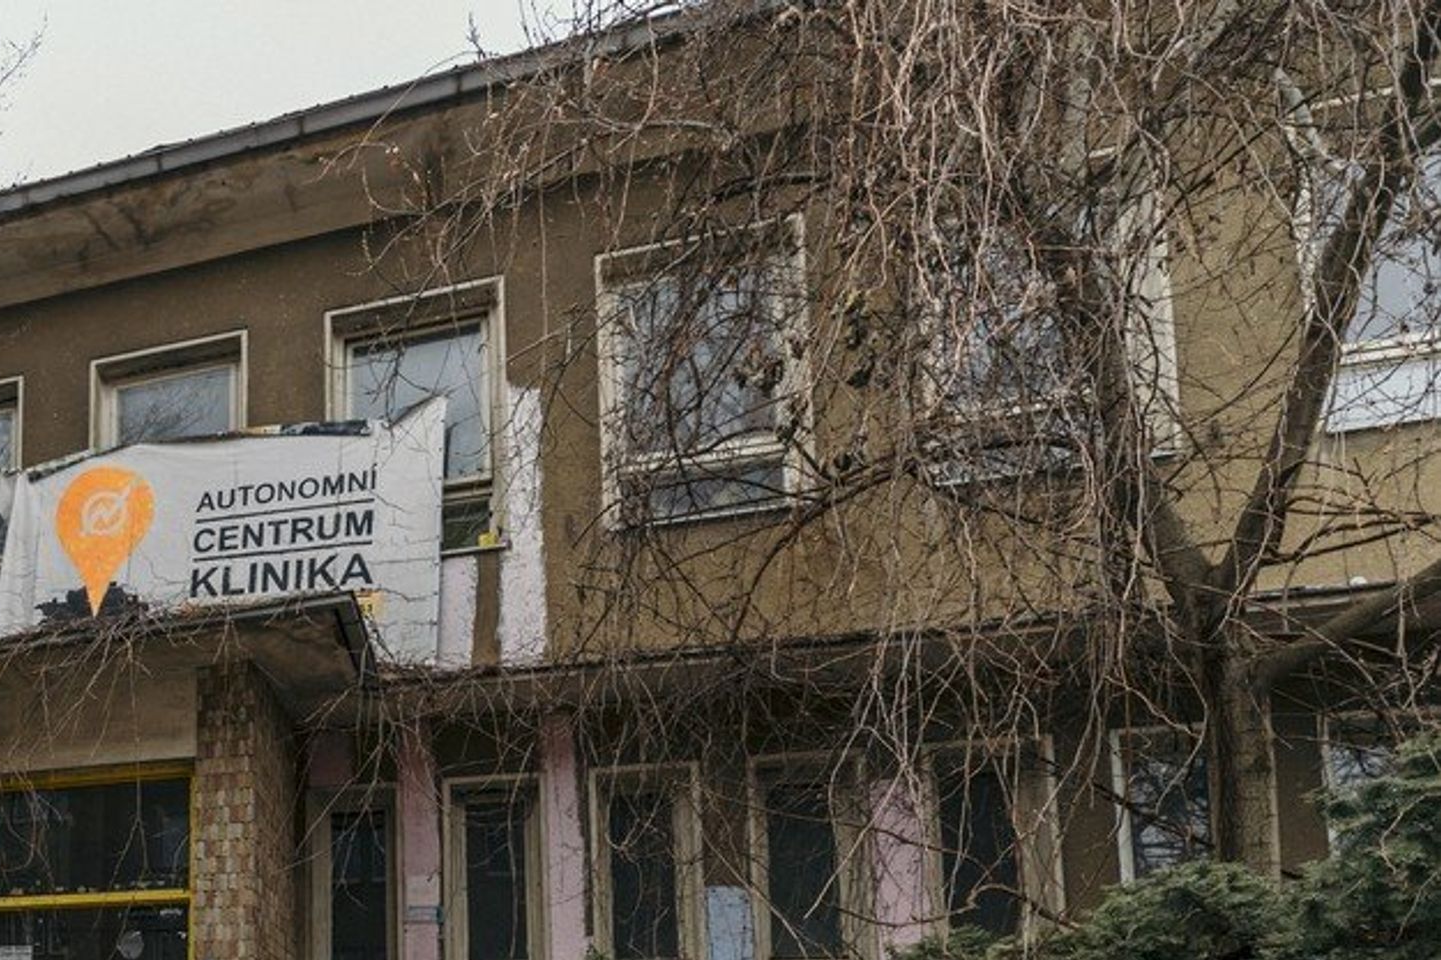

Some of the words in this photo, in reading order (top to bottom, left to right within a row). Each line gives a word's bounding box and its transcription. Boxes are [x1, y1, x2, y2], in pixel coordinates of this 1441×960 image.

[195, 463, 377, 513] AUTONOMNÍ
[193, 510, 374, 553] CENTRUM
[190, 553, 373, 598] KLINIKA
